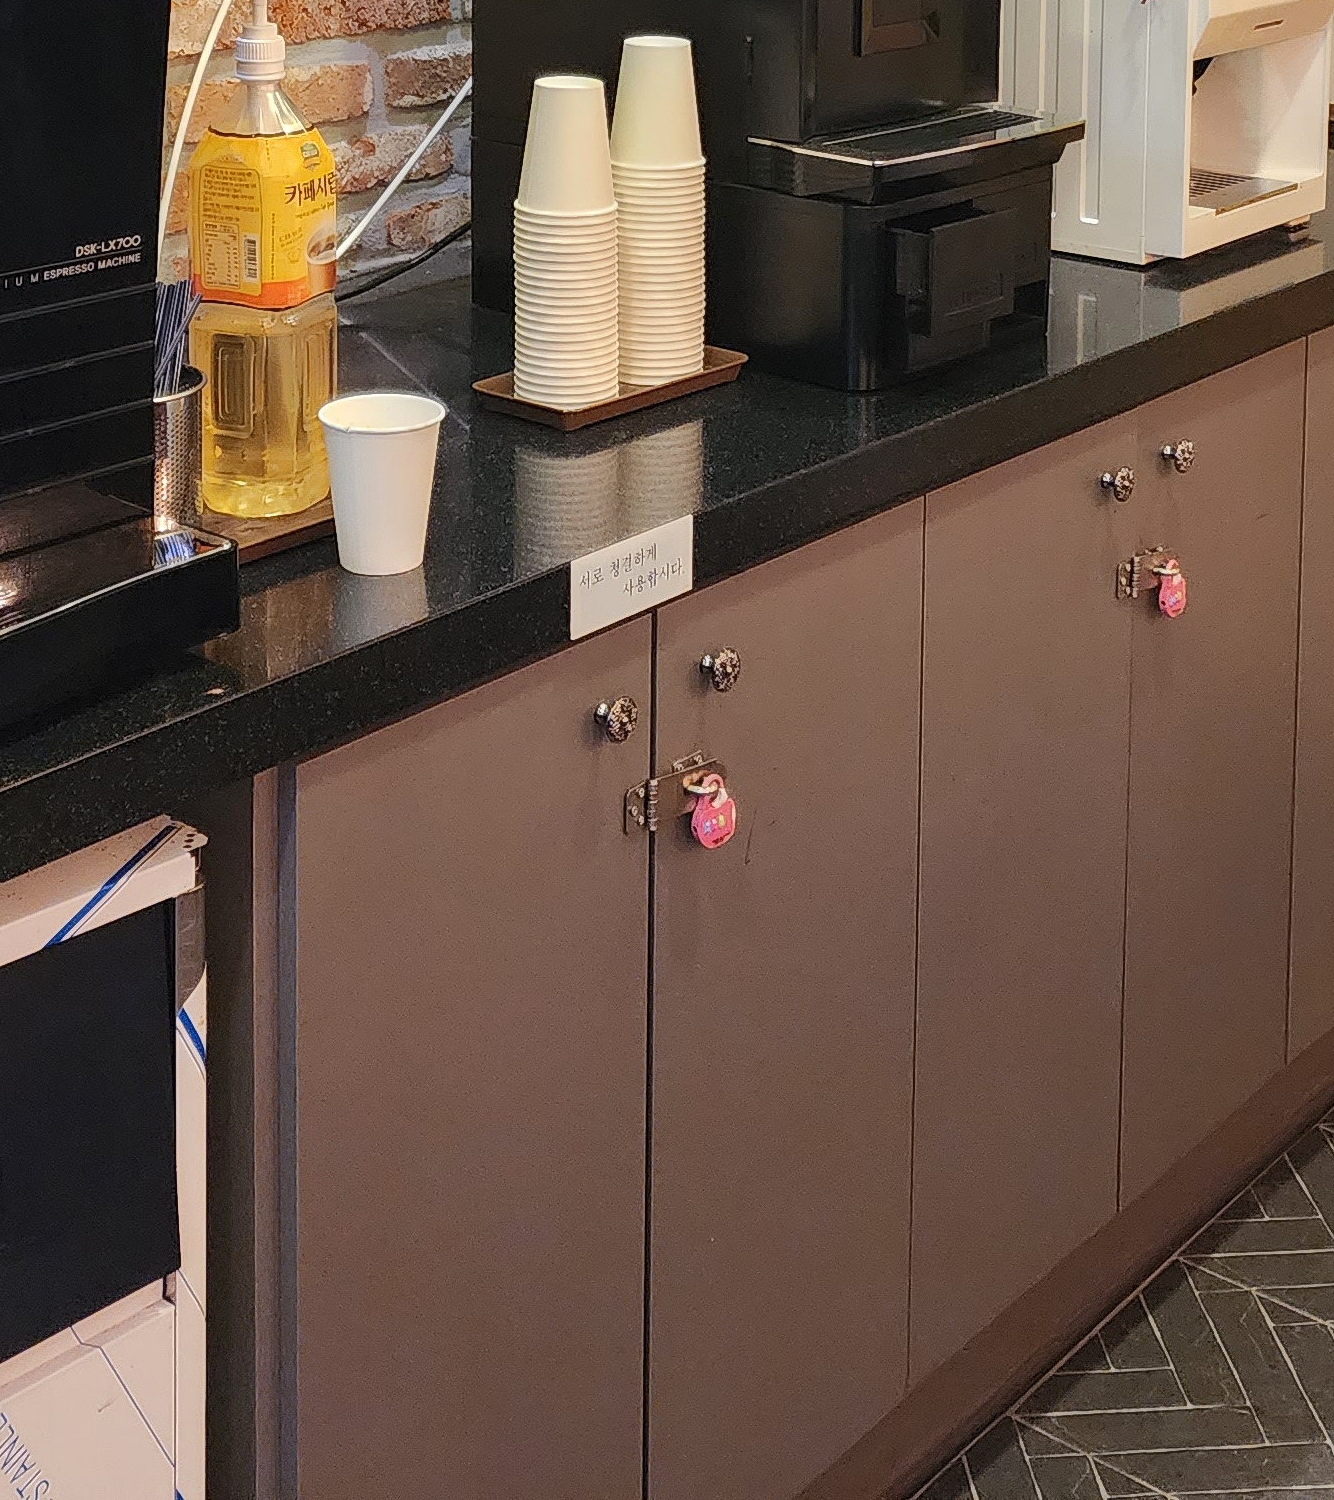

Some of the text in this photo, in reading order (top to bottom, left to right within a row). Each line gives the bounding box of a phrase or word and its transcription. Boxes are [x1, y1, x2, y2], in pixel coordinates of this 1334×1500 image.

[75, 234, 142, 259] DSK-LX700
[43, 261, 95, 281] ESPRESSO
[97, 253, 142, 270] MACHINE
[579, 543, 657, 590] 서로 청결하게
[622, 557, 685, 597] 사용합시다.
